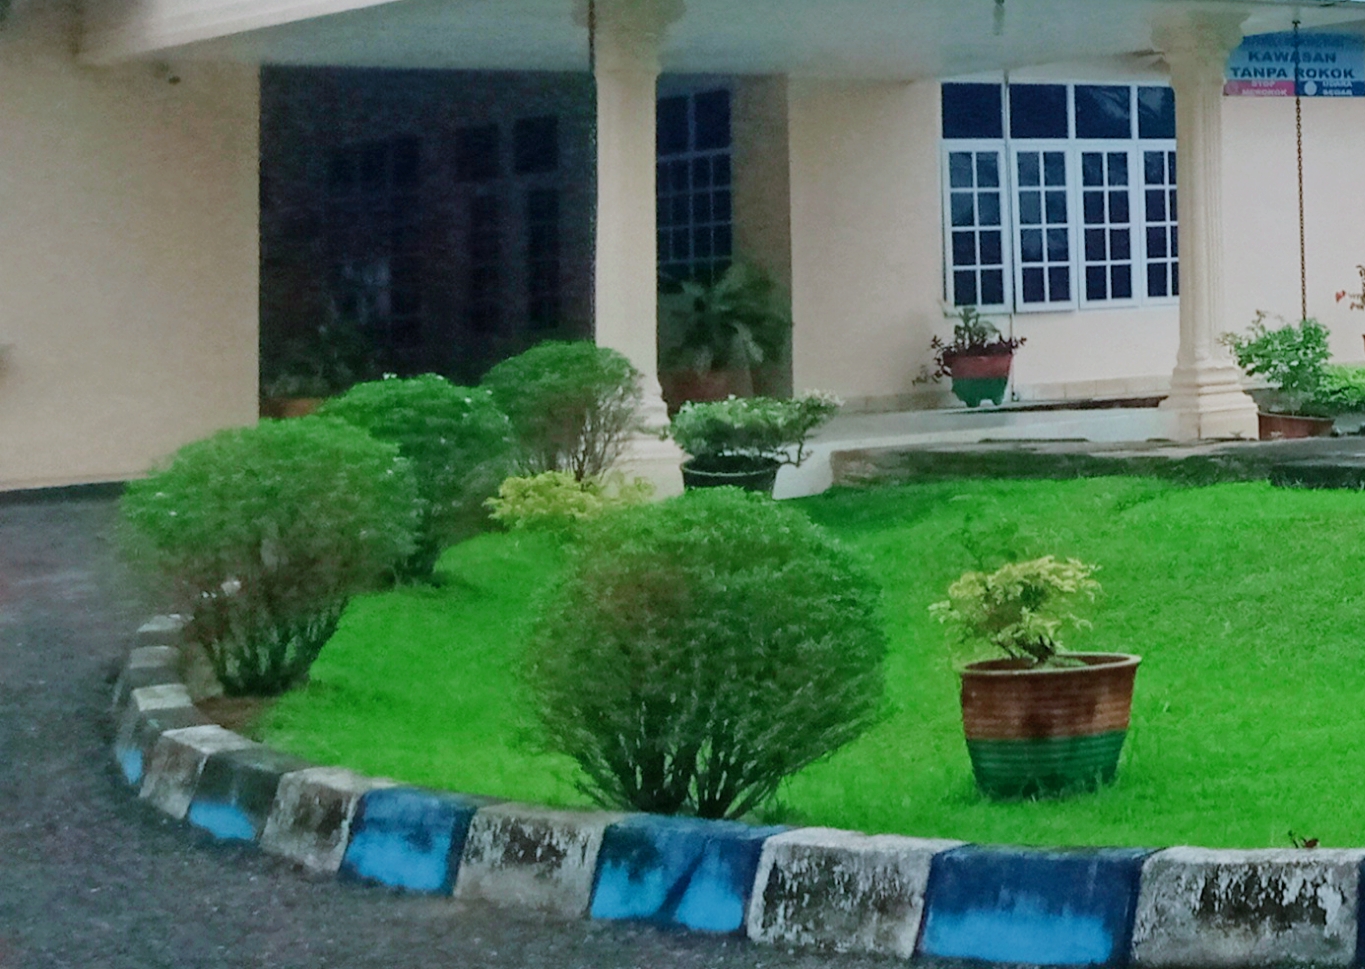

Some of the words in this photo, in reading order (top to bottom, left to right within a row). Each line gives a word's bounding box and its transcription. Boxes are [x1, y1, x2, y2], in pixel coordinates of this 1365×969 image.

[1248, 51, 1336, 63] KAWASAN
[1230, 67, 1288, 78] TANPA
[1295, 67, 1355, 79] ROKOK
